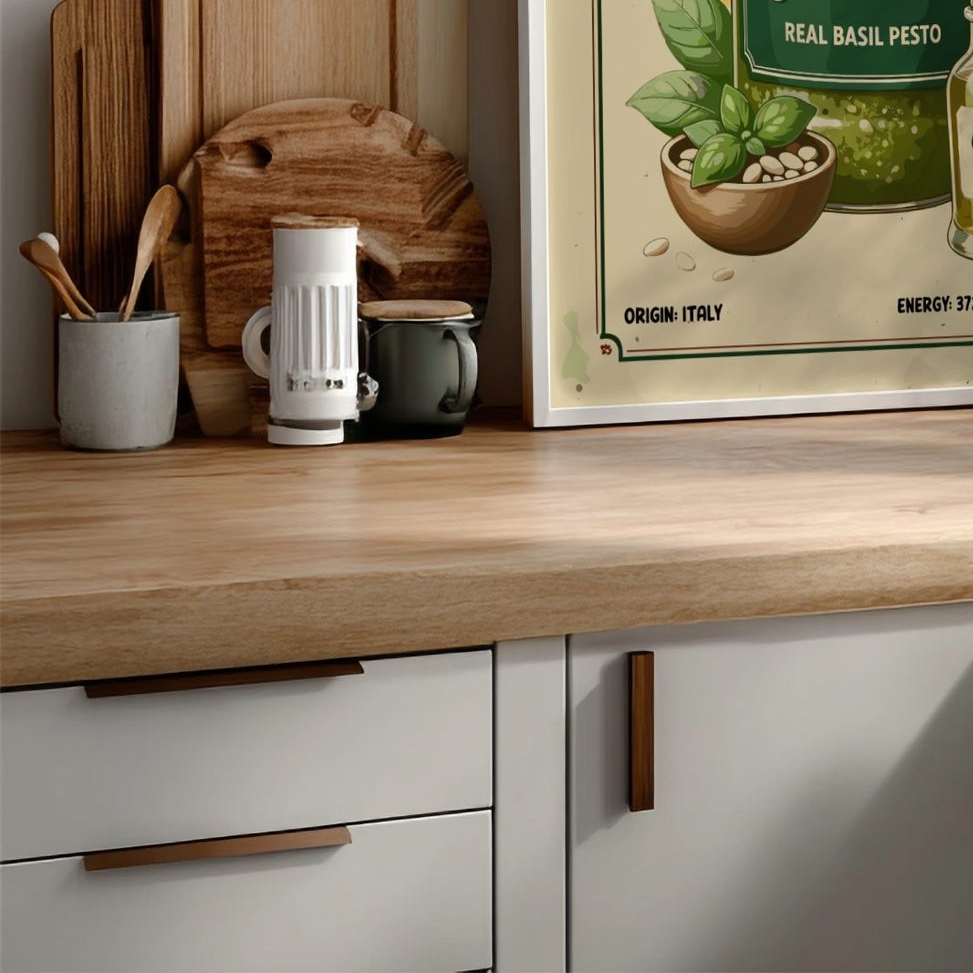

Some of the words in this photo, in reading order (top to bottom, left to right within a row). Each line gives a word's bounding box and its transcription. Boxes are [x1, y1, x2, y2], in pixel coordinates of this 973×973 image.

[784, 21, 828, 45] REAL
[833, 25, 884, 47] BASIL
[889, 23, 942, 46] PESTO
[624, 306, 678, 325] ORIGIN:
[682, 303, 723, 323] ITALY
[897, 295, 953, 314] ENERGY:
